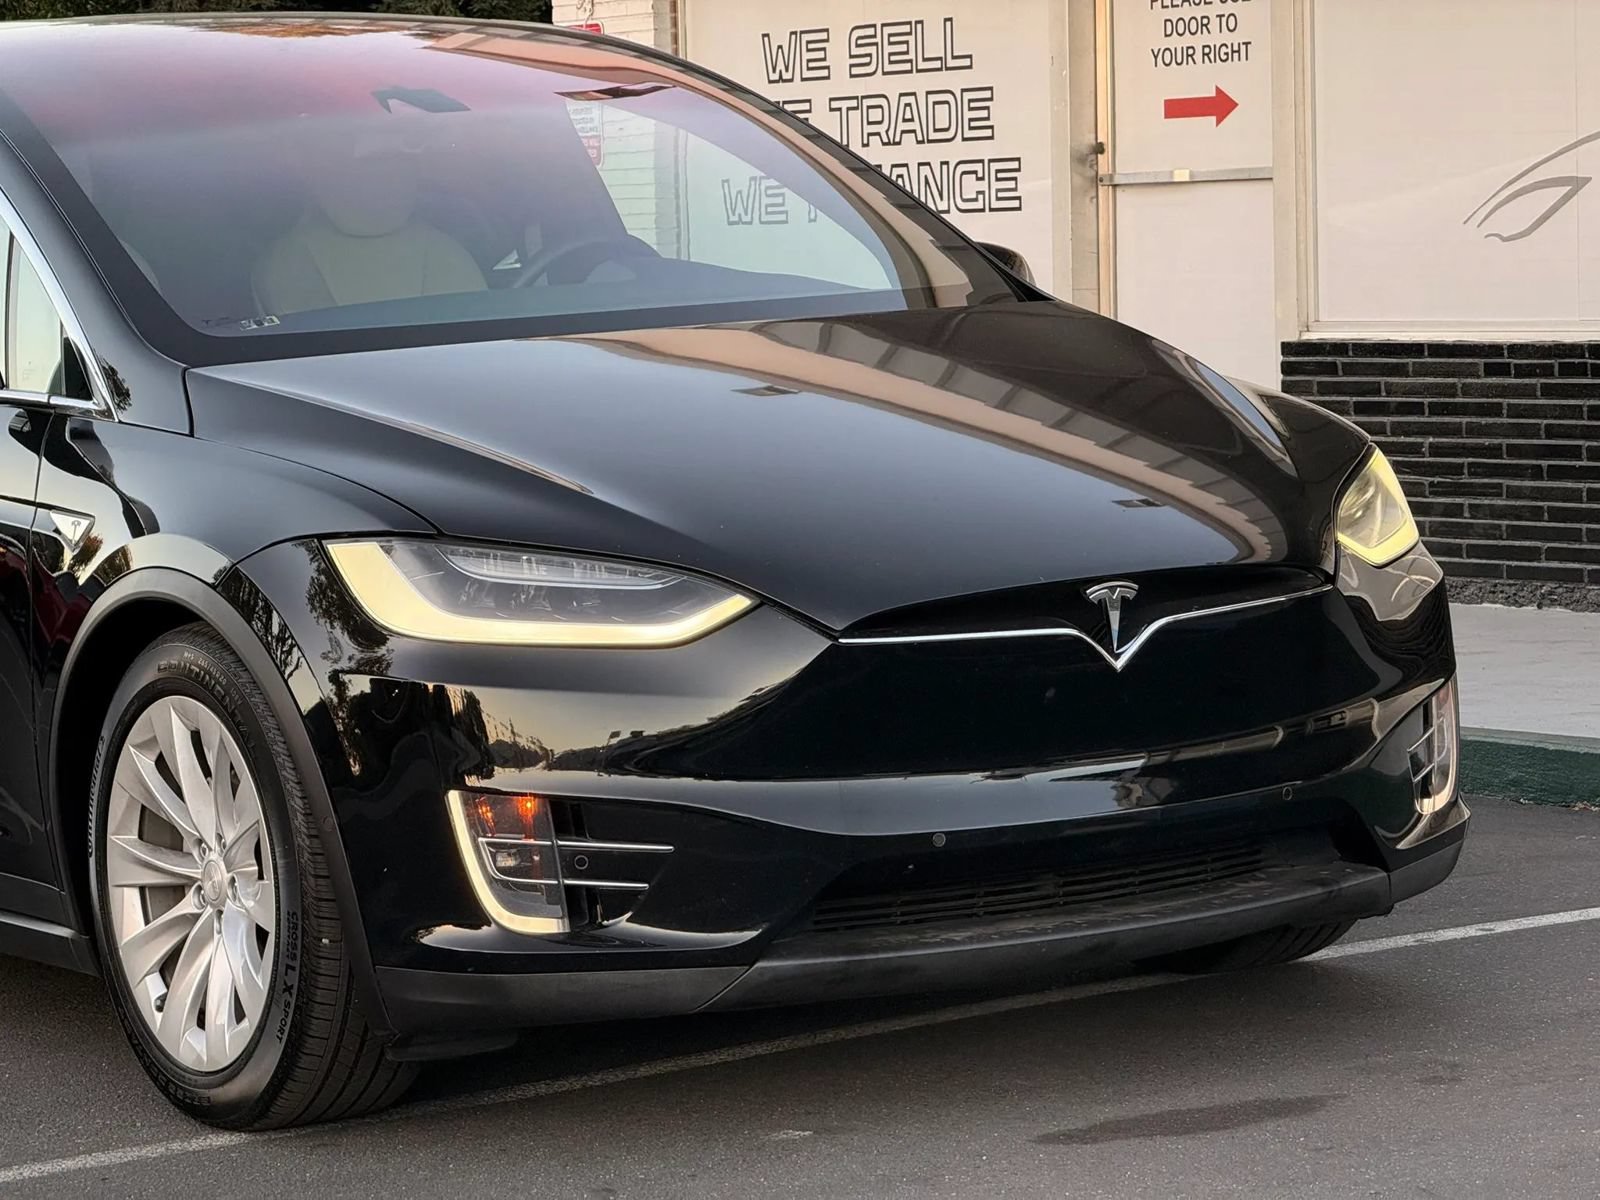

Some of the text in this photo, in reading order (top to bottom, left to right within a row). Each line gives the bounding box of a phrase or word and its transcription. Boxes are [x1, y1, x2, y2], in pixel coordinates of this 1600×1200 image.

[1163, 13, 1238, 38] DOOR TO
[761, 17, 973, 84] WE SELL
[1150, 41, 1252, 68] YOUR RIGHT
[829, 86, 995, 148] TRADE
[721, 176, 789, 225] WE
[275, 1000, 291, 1045] SPORT
